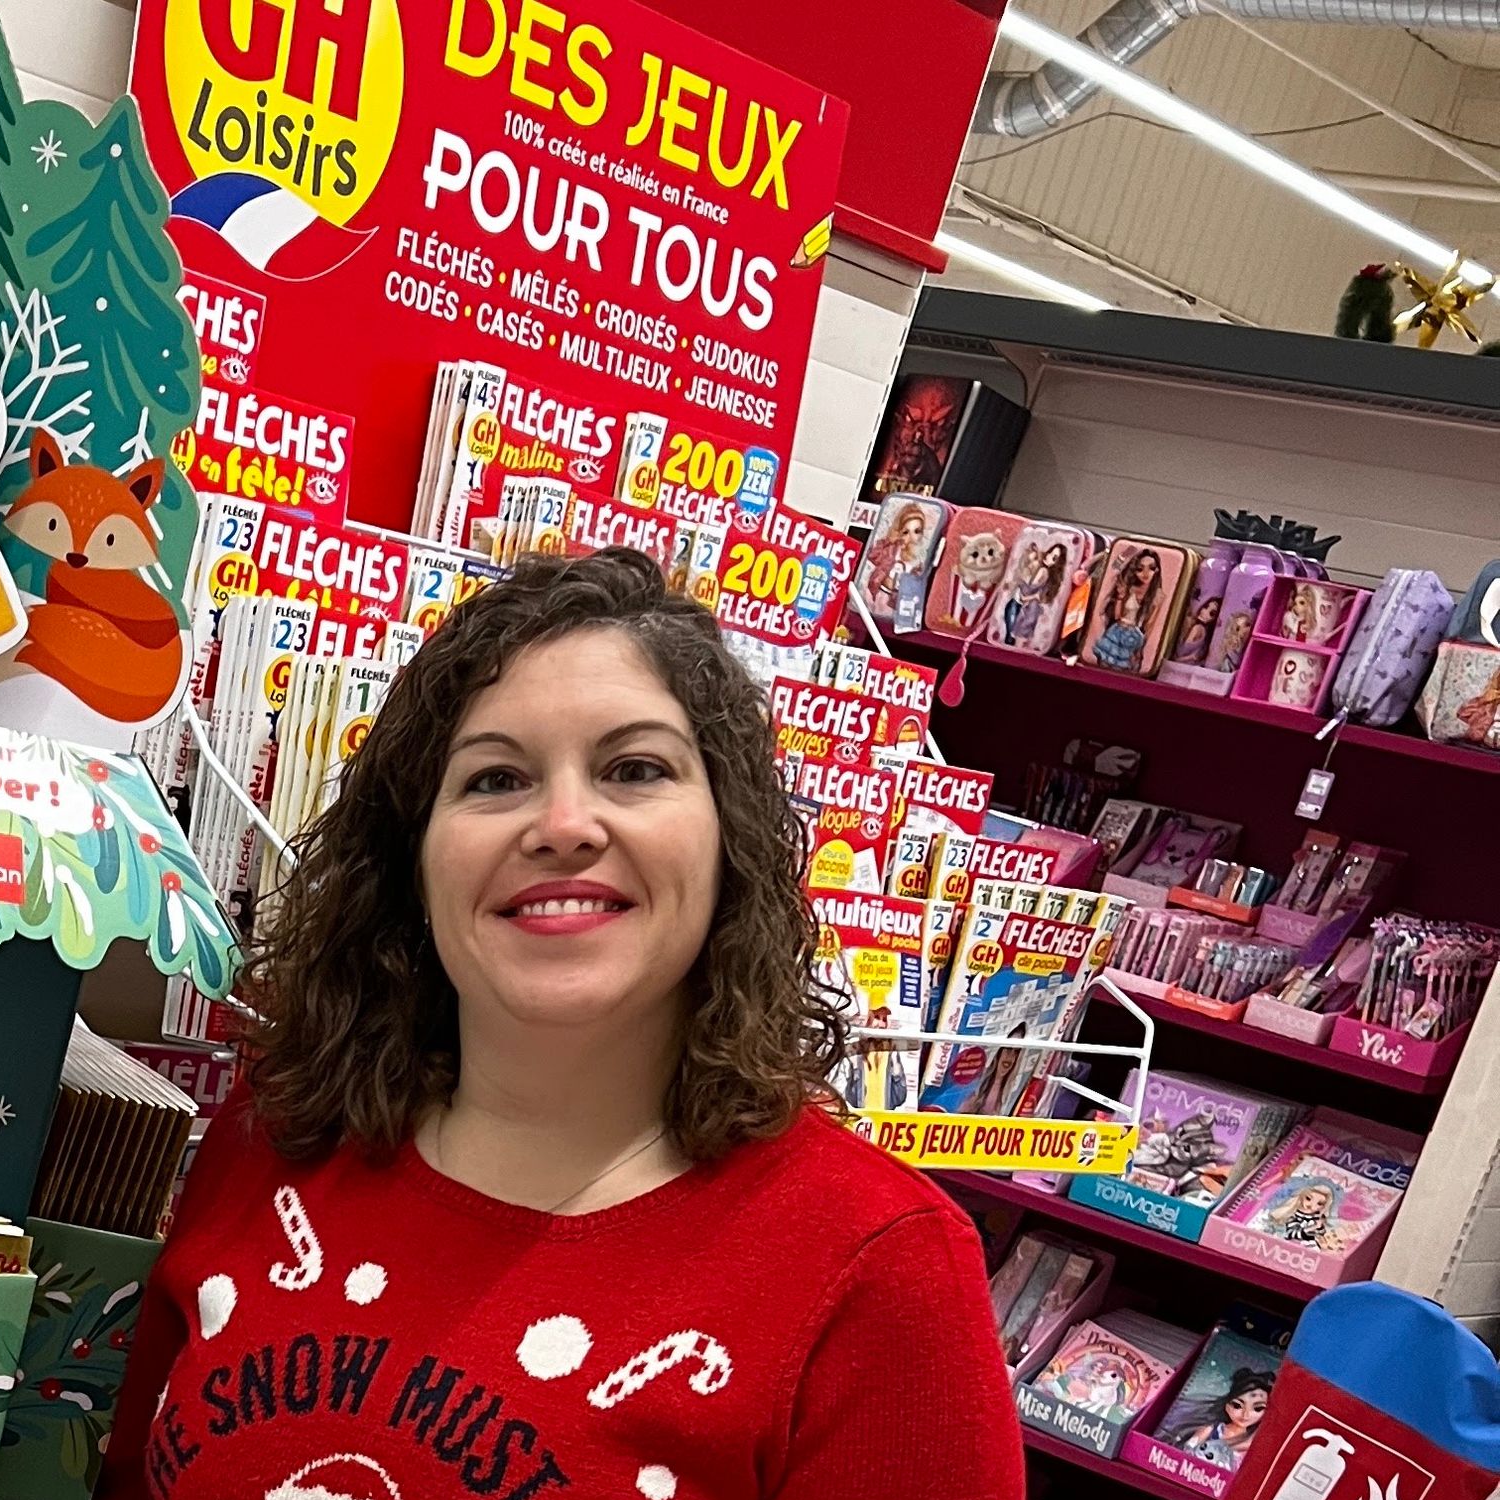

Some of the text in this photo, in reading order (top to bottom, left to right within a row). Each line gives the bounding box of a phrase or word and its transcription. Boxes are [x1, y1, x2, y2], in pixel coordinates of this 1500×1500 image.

[199, 0, 370, 122] GH
[445, 0, 803, 210] DES JEUX
[188, 79, 357, 197] Loisirs
[503, 110, 545, 149] 100%
[589, 153, 606, 178] et
[607, 161, 660, 197] réalisés
[662, 185, 682, 204] en
[682, 185, 730, 225] France
[423, 128, 778, 331] POUR TOUS
[397, 227, 779, 389] FLÉCHÉS MÊLÉS CROISÉS SUDOKUS
[385, 271, 778, 428] CODÉS CASÉS MULTIJEUX JEUNESSE
[195, 386, 348, 473] FLÉCHÉS
[474, 418, 497, 444] GH
[501, 383, 616, 457] FLÉCHÉS
[199, 446, 306, 506] en fête!
[500, 442, 564, 473] malins
[635, 467, 657, 491] GH
[662, 432, 745, 498] 200
[655, 481, 736, 529] FLÉCHÉS
[743, 472, 771, 494] ZEN
[223, 503, 257, 521] FLÉCHÉS
[217, 559, 253, 596] GH
[259, 521, 401, 603] FLÉCHÉS
[722, 542, 803, 606] 200
[694, 577, 716, 602] GH
[801, 580, 825, 602] ZEN
[275, 606, 311, 621] FLÉCHÉS
[716, 592, 795, 638] FLÉCHÉS
[351, 667, 390, 684] FLÉCHÉS
[864, 668, 934, 714] FLÉCHÉS
[772, 685, 876, 742] FLÉCHÉS
[50, 781, 60, 807] !
[802, 764, 892, 815] FLÉCHÉS
[903, 769, 989, 813] FLÉCHÉS
[819, 804, 862, 835] Vogue
[237, 828, 255, 887] FLÉCHÉS
[901, 868, 927, 889] GH
[969, 843, 1054, 885] FLÉCHÉS
[945, 873, 966, 894] GH
[812, 896, 923, 938] Multijeux
[1005, 918, 1092, 959] FLÉCHÉES
[931, 938, 950, 956] GH
[972, 943, 998, 965] GH
[877, 1121, 917, 1152] DES
[918, 1123, 967, 1159] JEUX
[971, 1127, 1025, 1157] POUR
[1031, 1129, 1077, 1159] TOUS
[1094, 1182, 1180, 1223] TOPModel
[1223, 1227, 1320, 1275] TOPModel
[202, 1333, 392, 1438] SNOW
[1016, 1387, 1111, 1452] Miss Melody
[1148, 1445, 1227, 1498] Miss Melody
